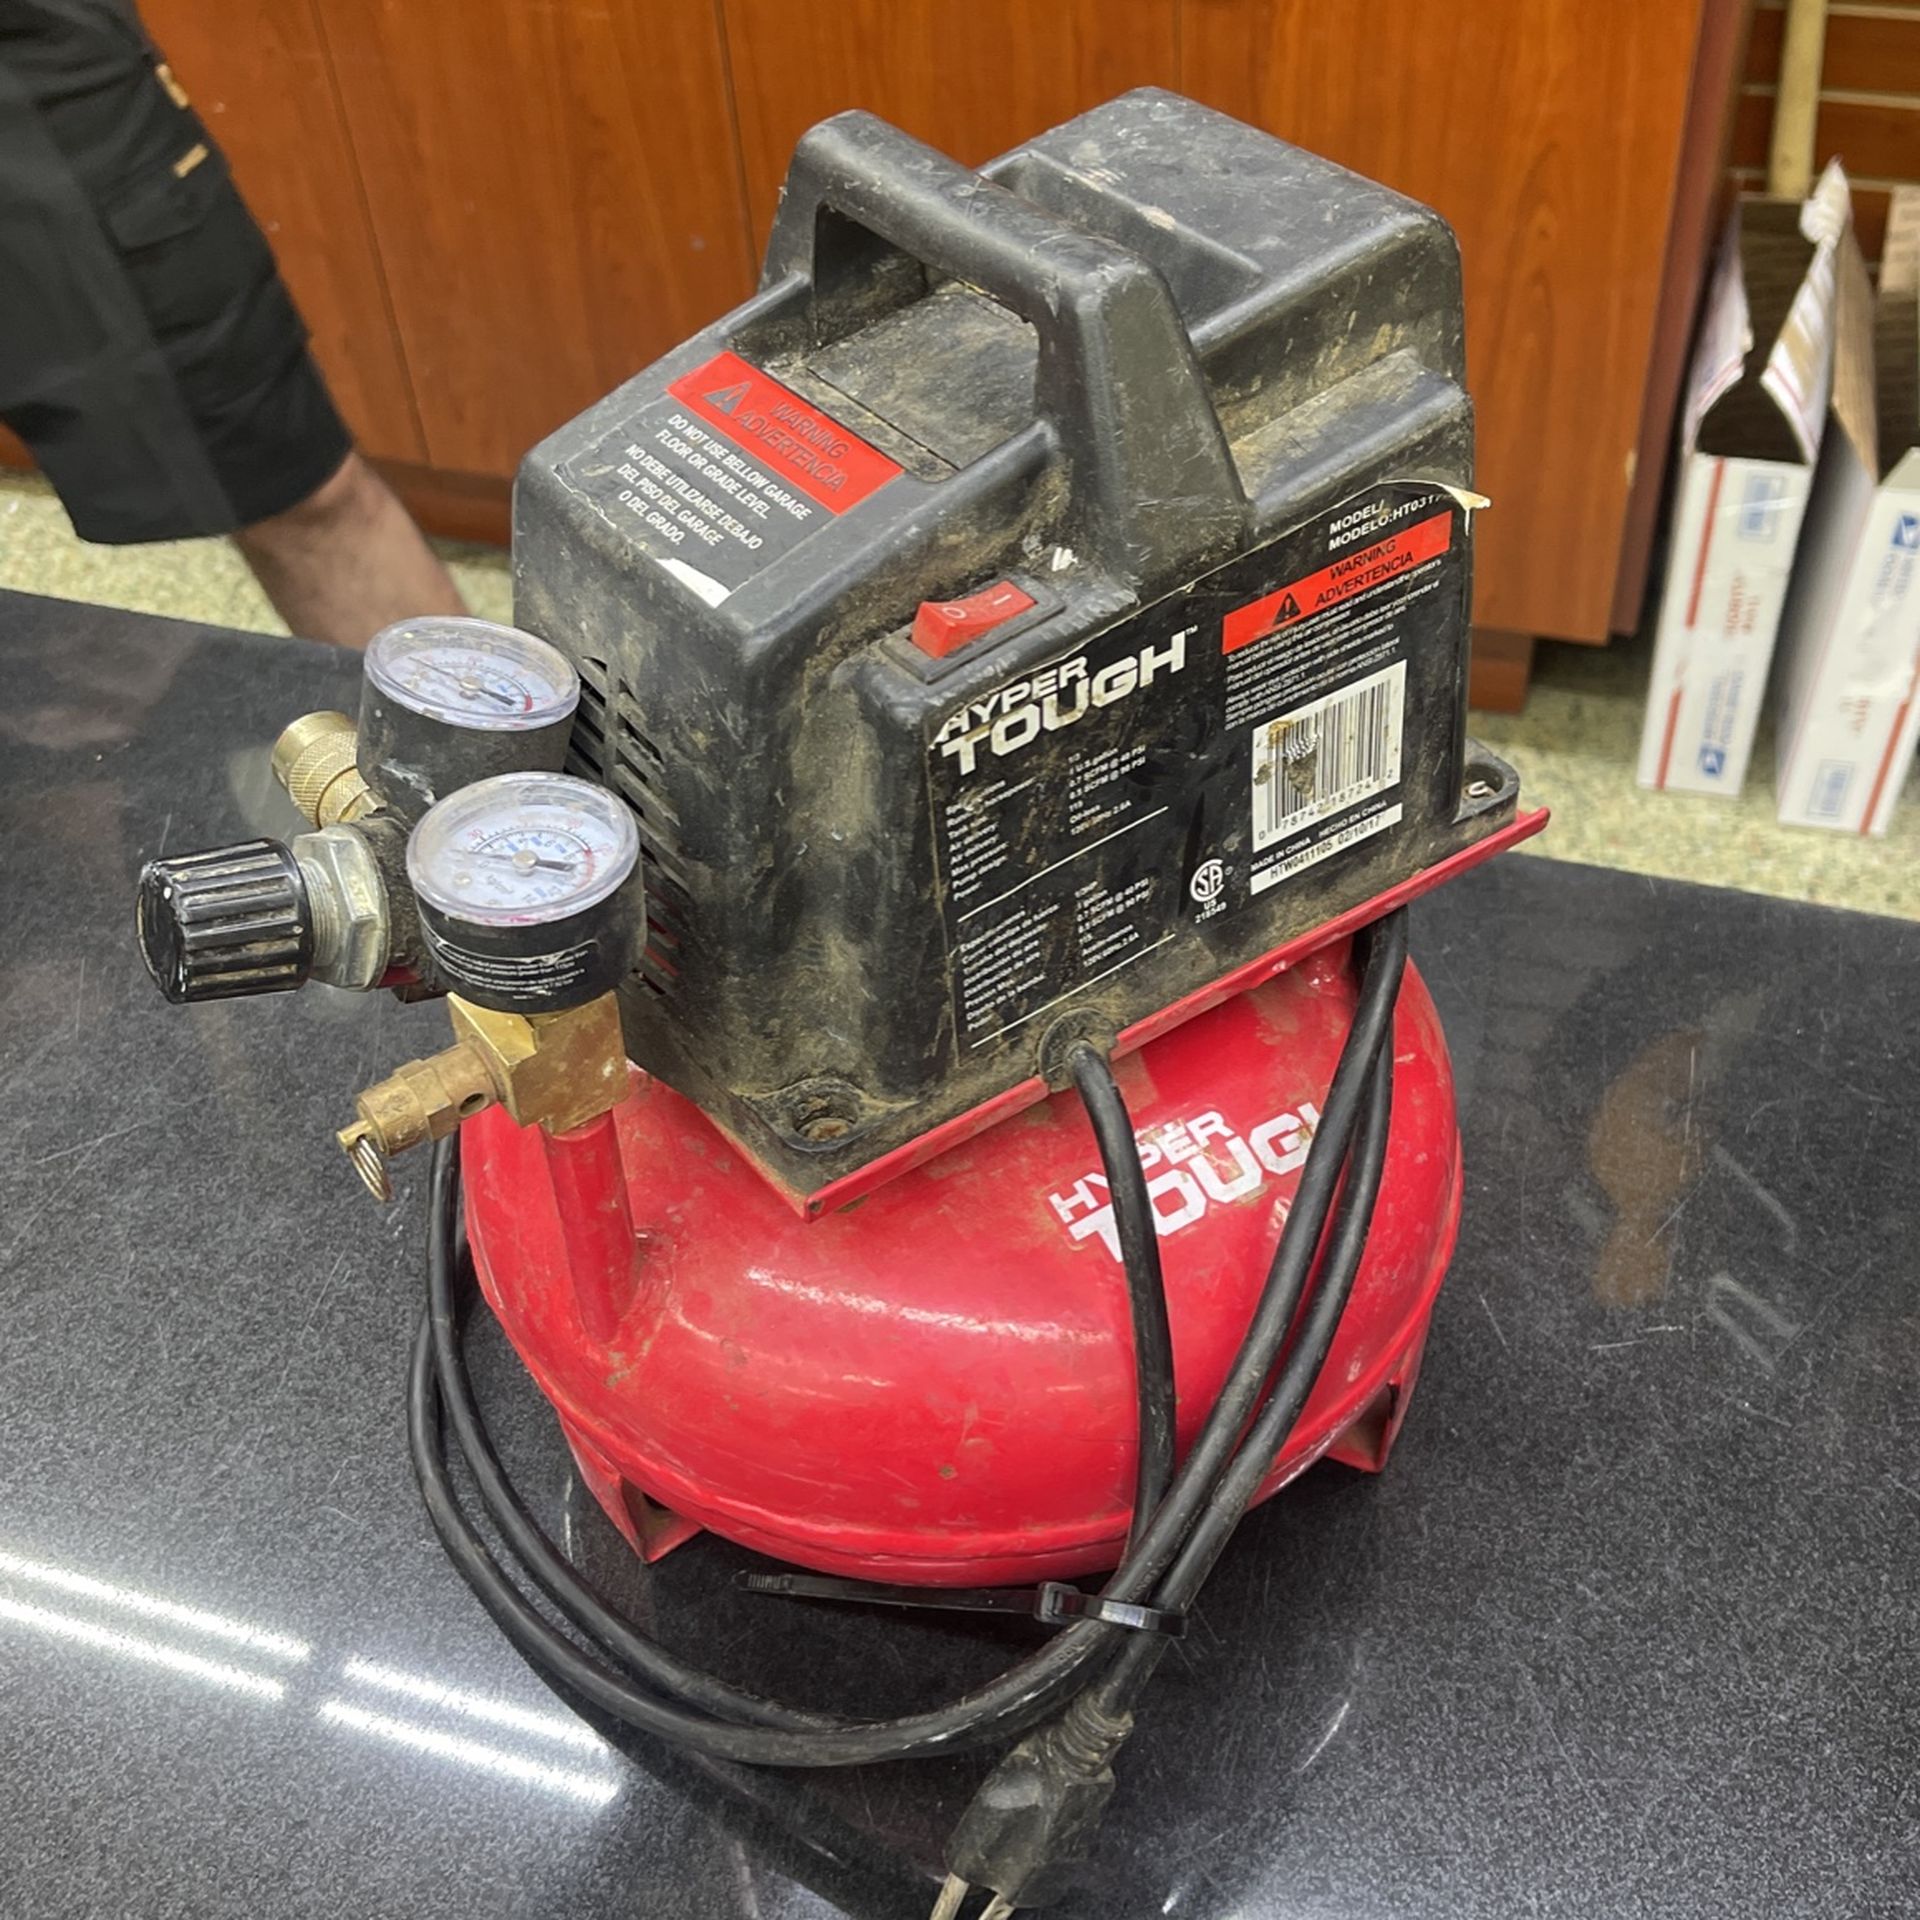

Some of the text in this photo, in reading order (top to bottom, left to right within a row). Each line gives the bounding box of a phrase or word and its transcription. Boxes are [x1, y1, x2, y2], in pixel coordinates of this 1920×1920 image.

[736, 411, 849, 492] ADVERTENCIA
[770, 401, 850, 459] WARNING
[655, 429, 772, 519] FLOOR OR GRADE LEVEL.
[667, 414, 812, 521] DO NOT USE BELLOW GARAGE
[617, 463, 724, 546] DEL PISO DEL GARAGE
[618, 490, 685, 545] O DEL GRADO.
[625, 444, 763, 549] NO DEBE UTILIZARSE DEBAJO
[1315, 551, 1414, 607] ADVERTENCIA
[1329, 539, 1397, 580] WARNING
[941, 631, 1186, 776] TOUGH
[1083, 761, 1108, 781] SCFM
[1131, 743, 1145, 756] PSI
[1083, 773, 1108, 793] SCFM
[1132, 755, 1145, 769] PSI
[1361, 800, 1387, 817] CHINA
[1250, 837, 1312, 872] MADE IN CHINA
[1090, 895, 1113, 915] SCFM
[1134, 876, 1148, 890] PSI
